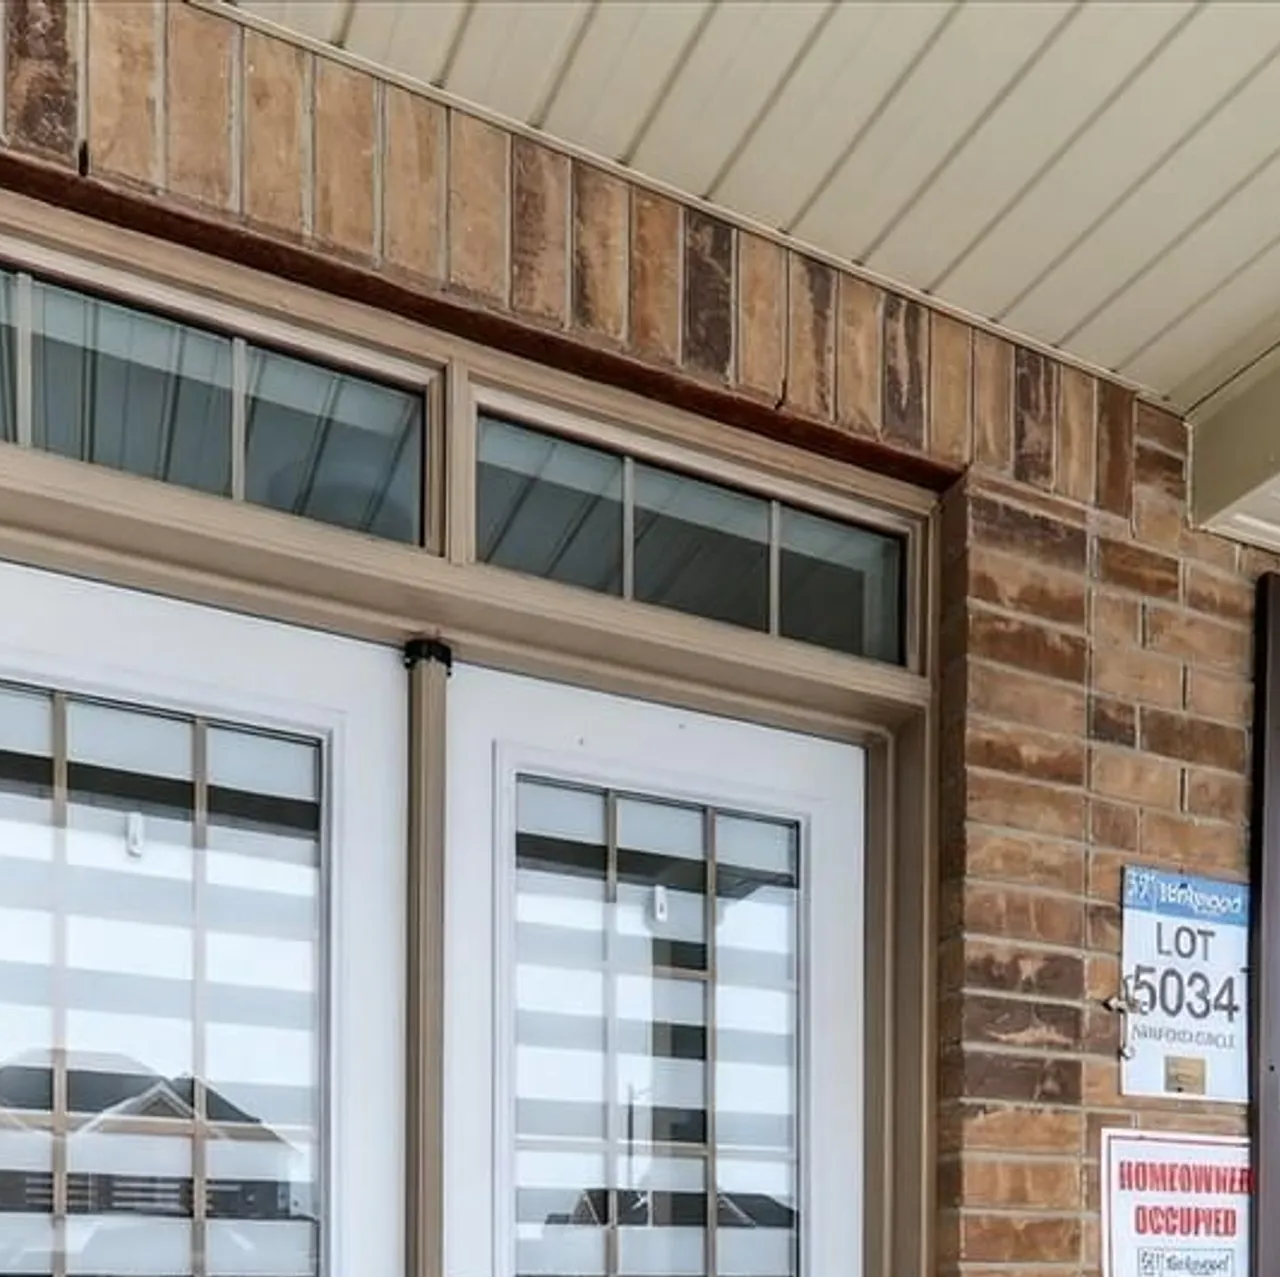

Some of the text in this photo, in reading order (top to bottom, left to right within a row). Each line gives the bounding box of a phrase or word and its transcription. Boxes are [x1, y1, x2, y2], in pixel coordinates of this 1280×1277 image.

[1155, 921, 1216, 961] LOT
[1132, 964, 1240, 1022] 5034
[1134, 1204, 1237, 1237] OCCUPIED
